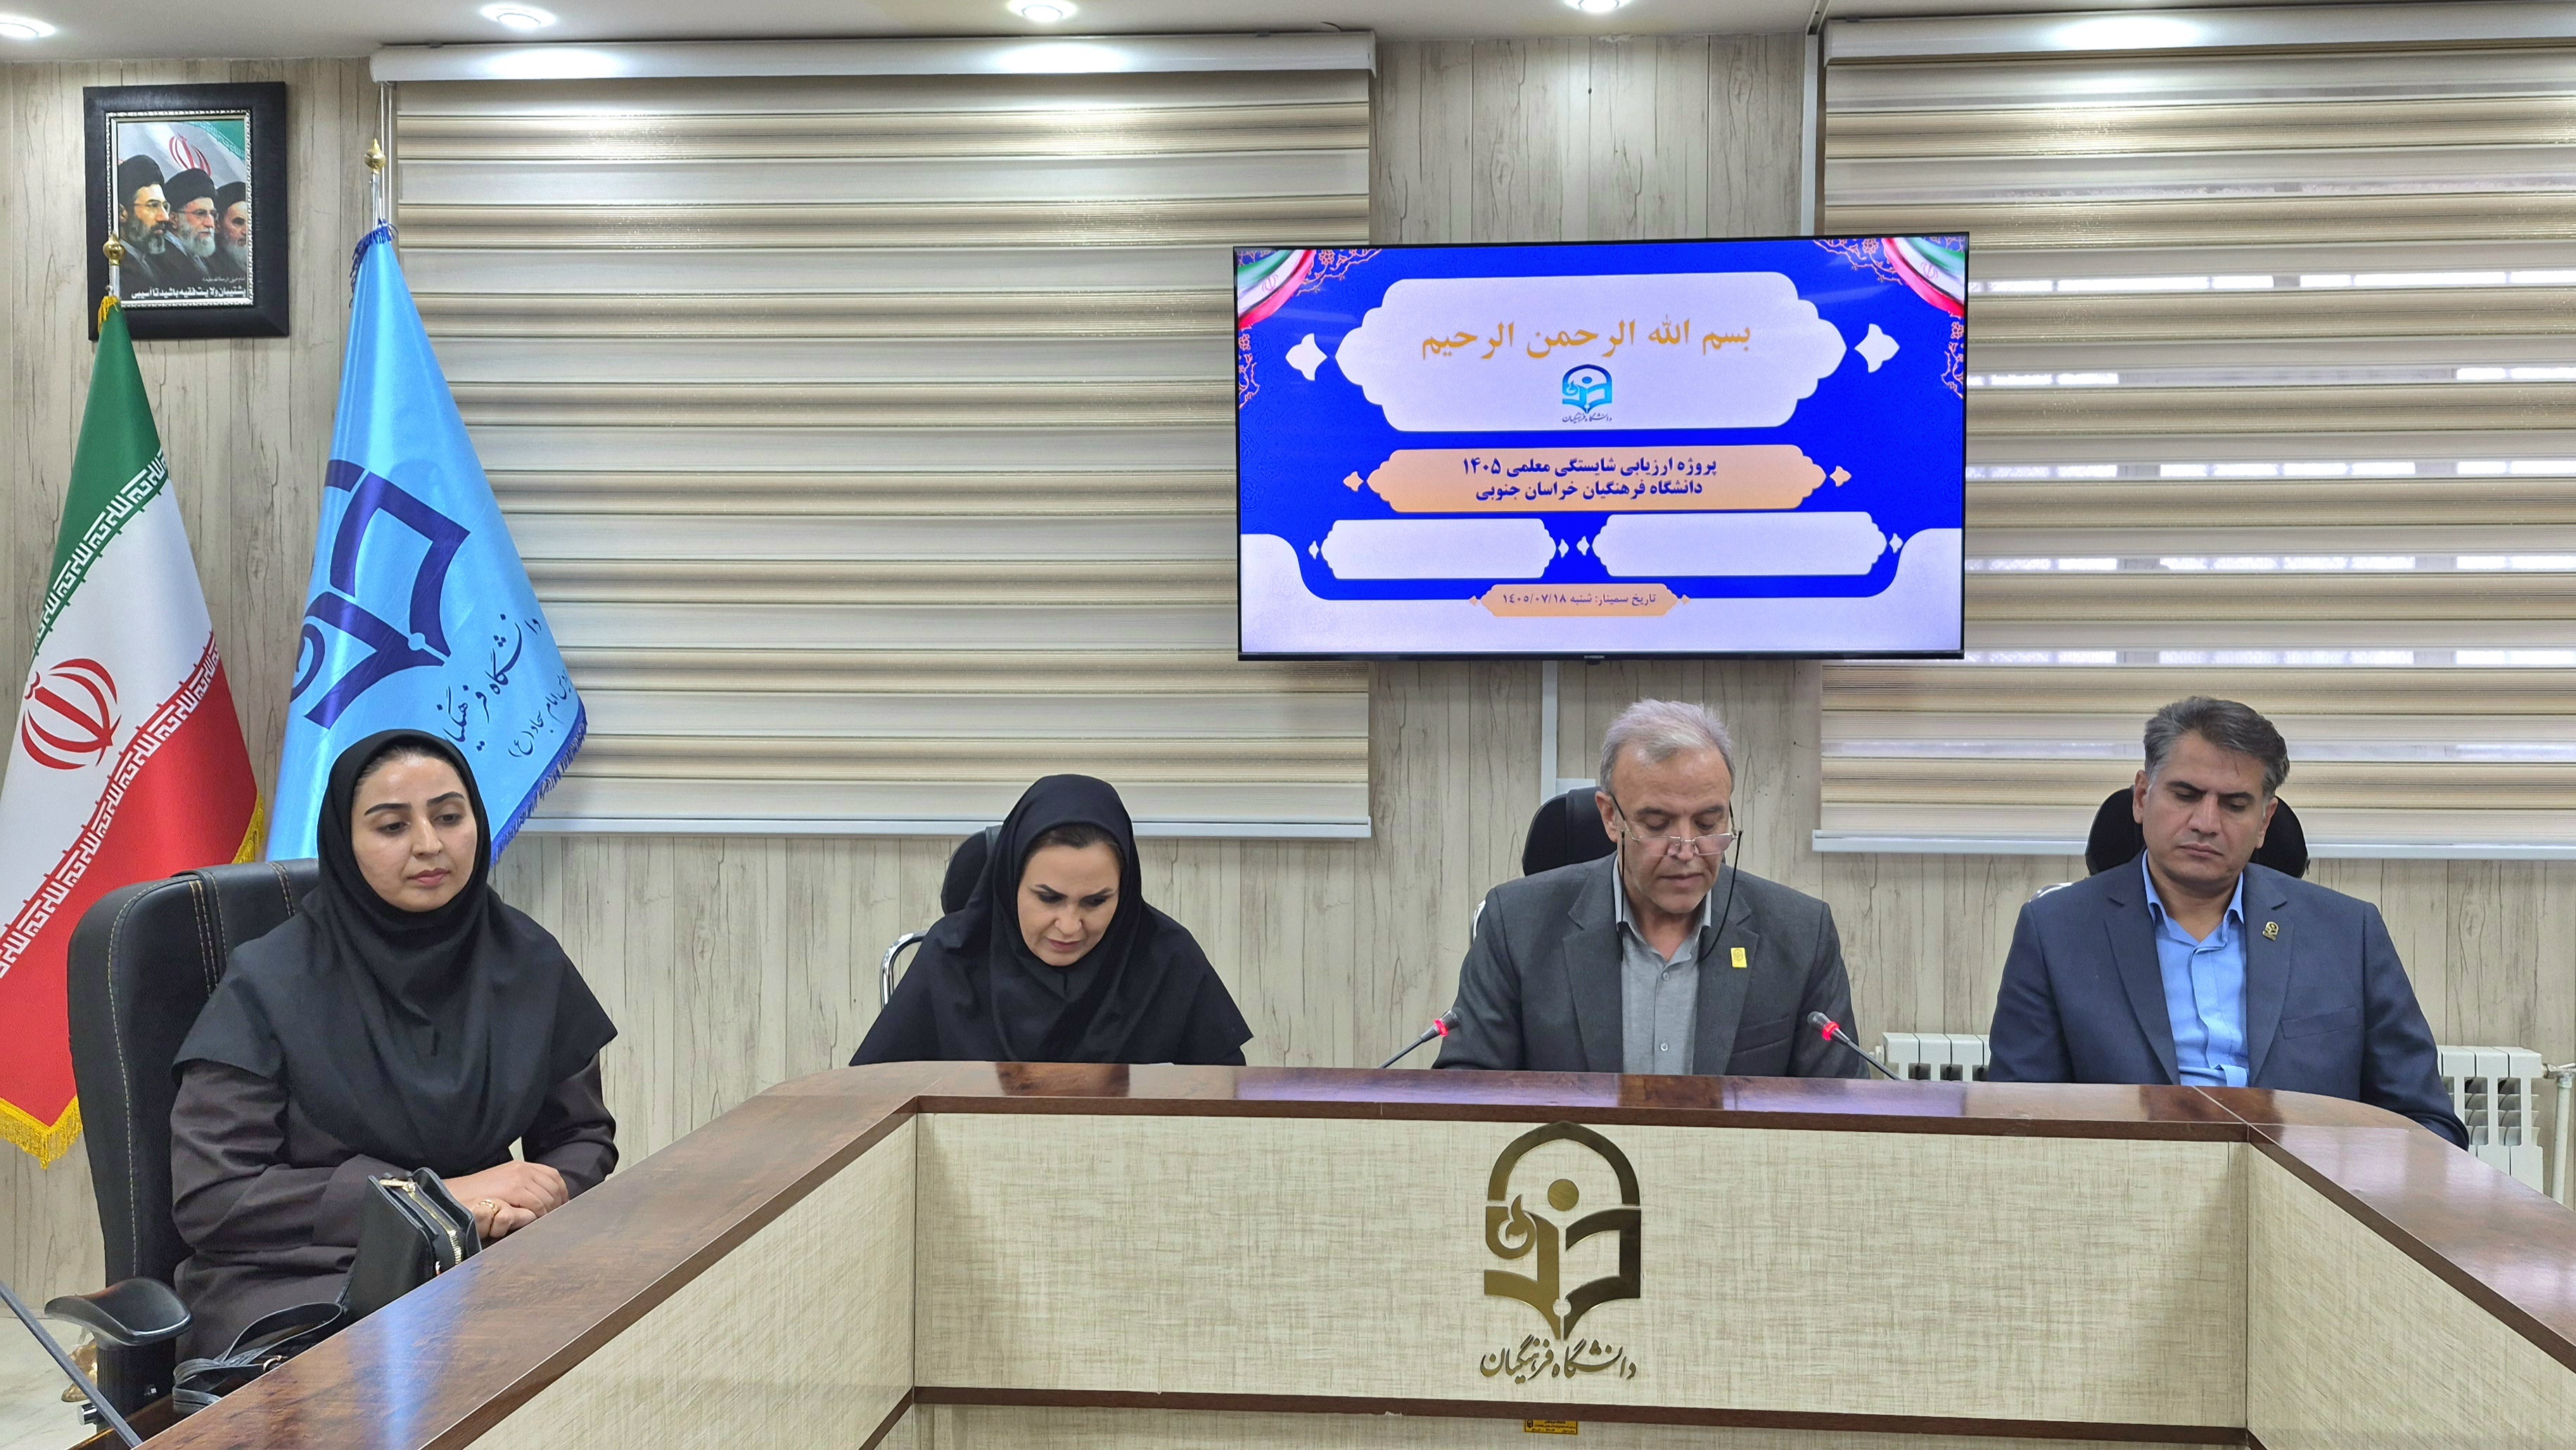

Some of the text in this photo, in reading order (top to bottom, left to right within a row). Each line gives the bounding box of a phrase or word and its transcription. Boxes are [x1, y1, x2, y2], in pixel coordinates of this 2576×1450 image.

[1422, 314, 1751, 360] بسم الله الرحمن الرحیم
[1462, 456, 1717, 477] پروژه ارزیابی شایستگی معلمی ۱۴۰۵
[1475, 479, 1703, 501] دانشگاه فرهنگیان خراسان جنوبی
[1569, 593, 1593, 605] شنبه
[1631, 594, 1656, 606] تاریخ
[436, 684, 490, 752] فرهنگیا
[1479, 1333, 1637, 1385] دانشگاه فرهنگیان
